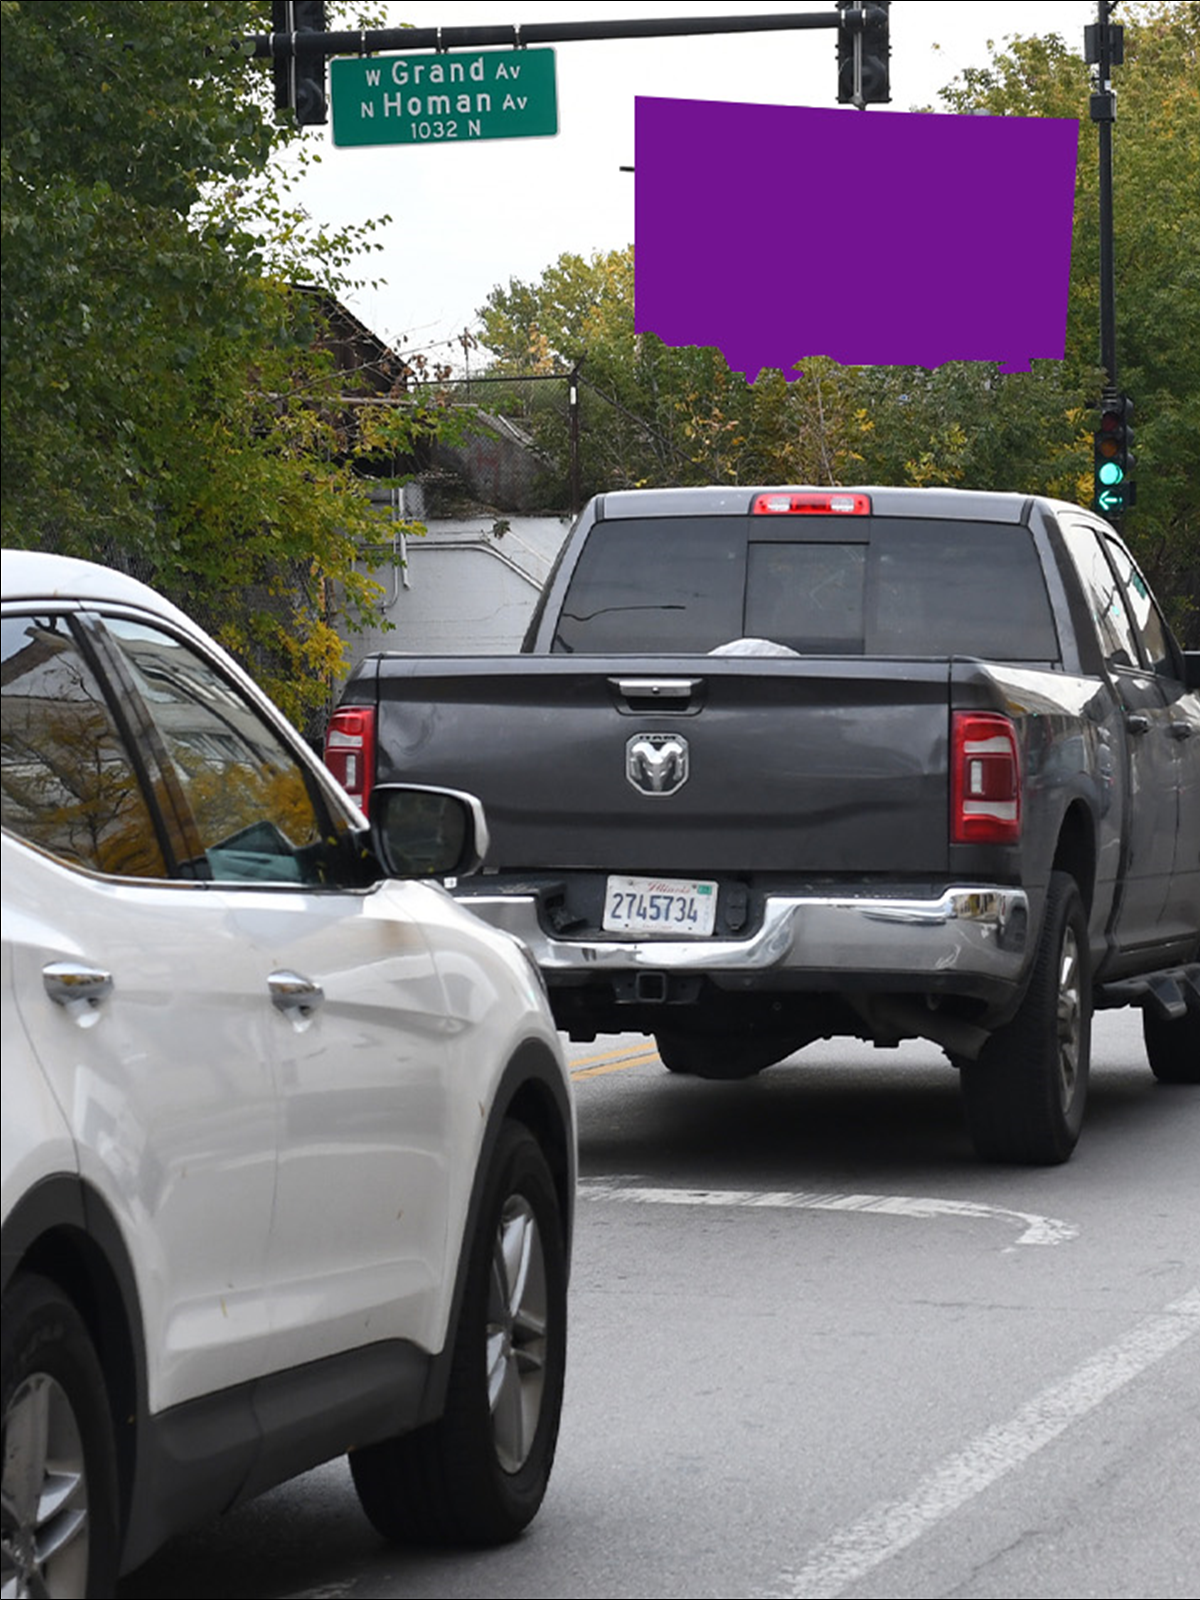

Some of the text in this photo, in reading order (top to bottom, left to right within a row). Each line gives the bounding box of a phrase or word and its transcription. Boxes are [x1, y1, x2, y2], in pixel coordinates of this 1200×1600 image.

[366, 57, 521, 86] W Grand Av
[361, 92, 527, 118] N Homan Av
[411, 119, 481, 139] 1032 N
[610, 893, 697, 923] 2745734
